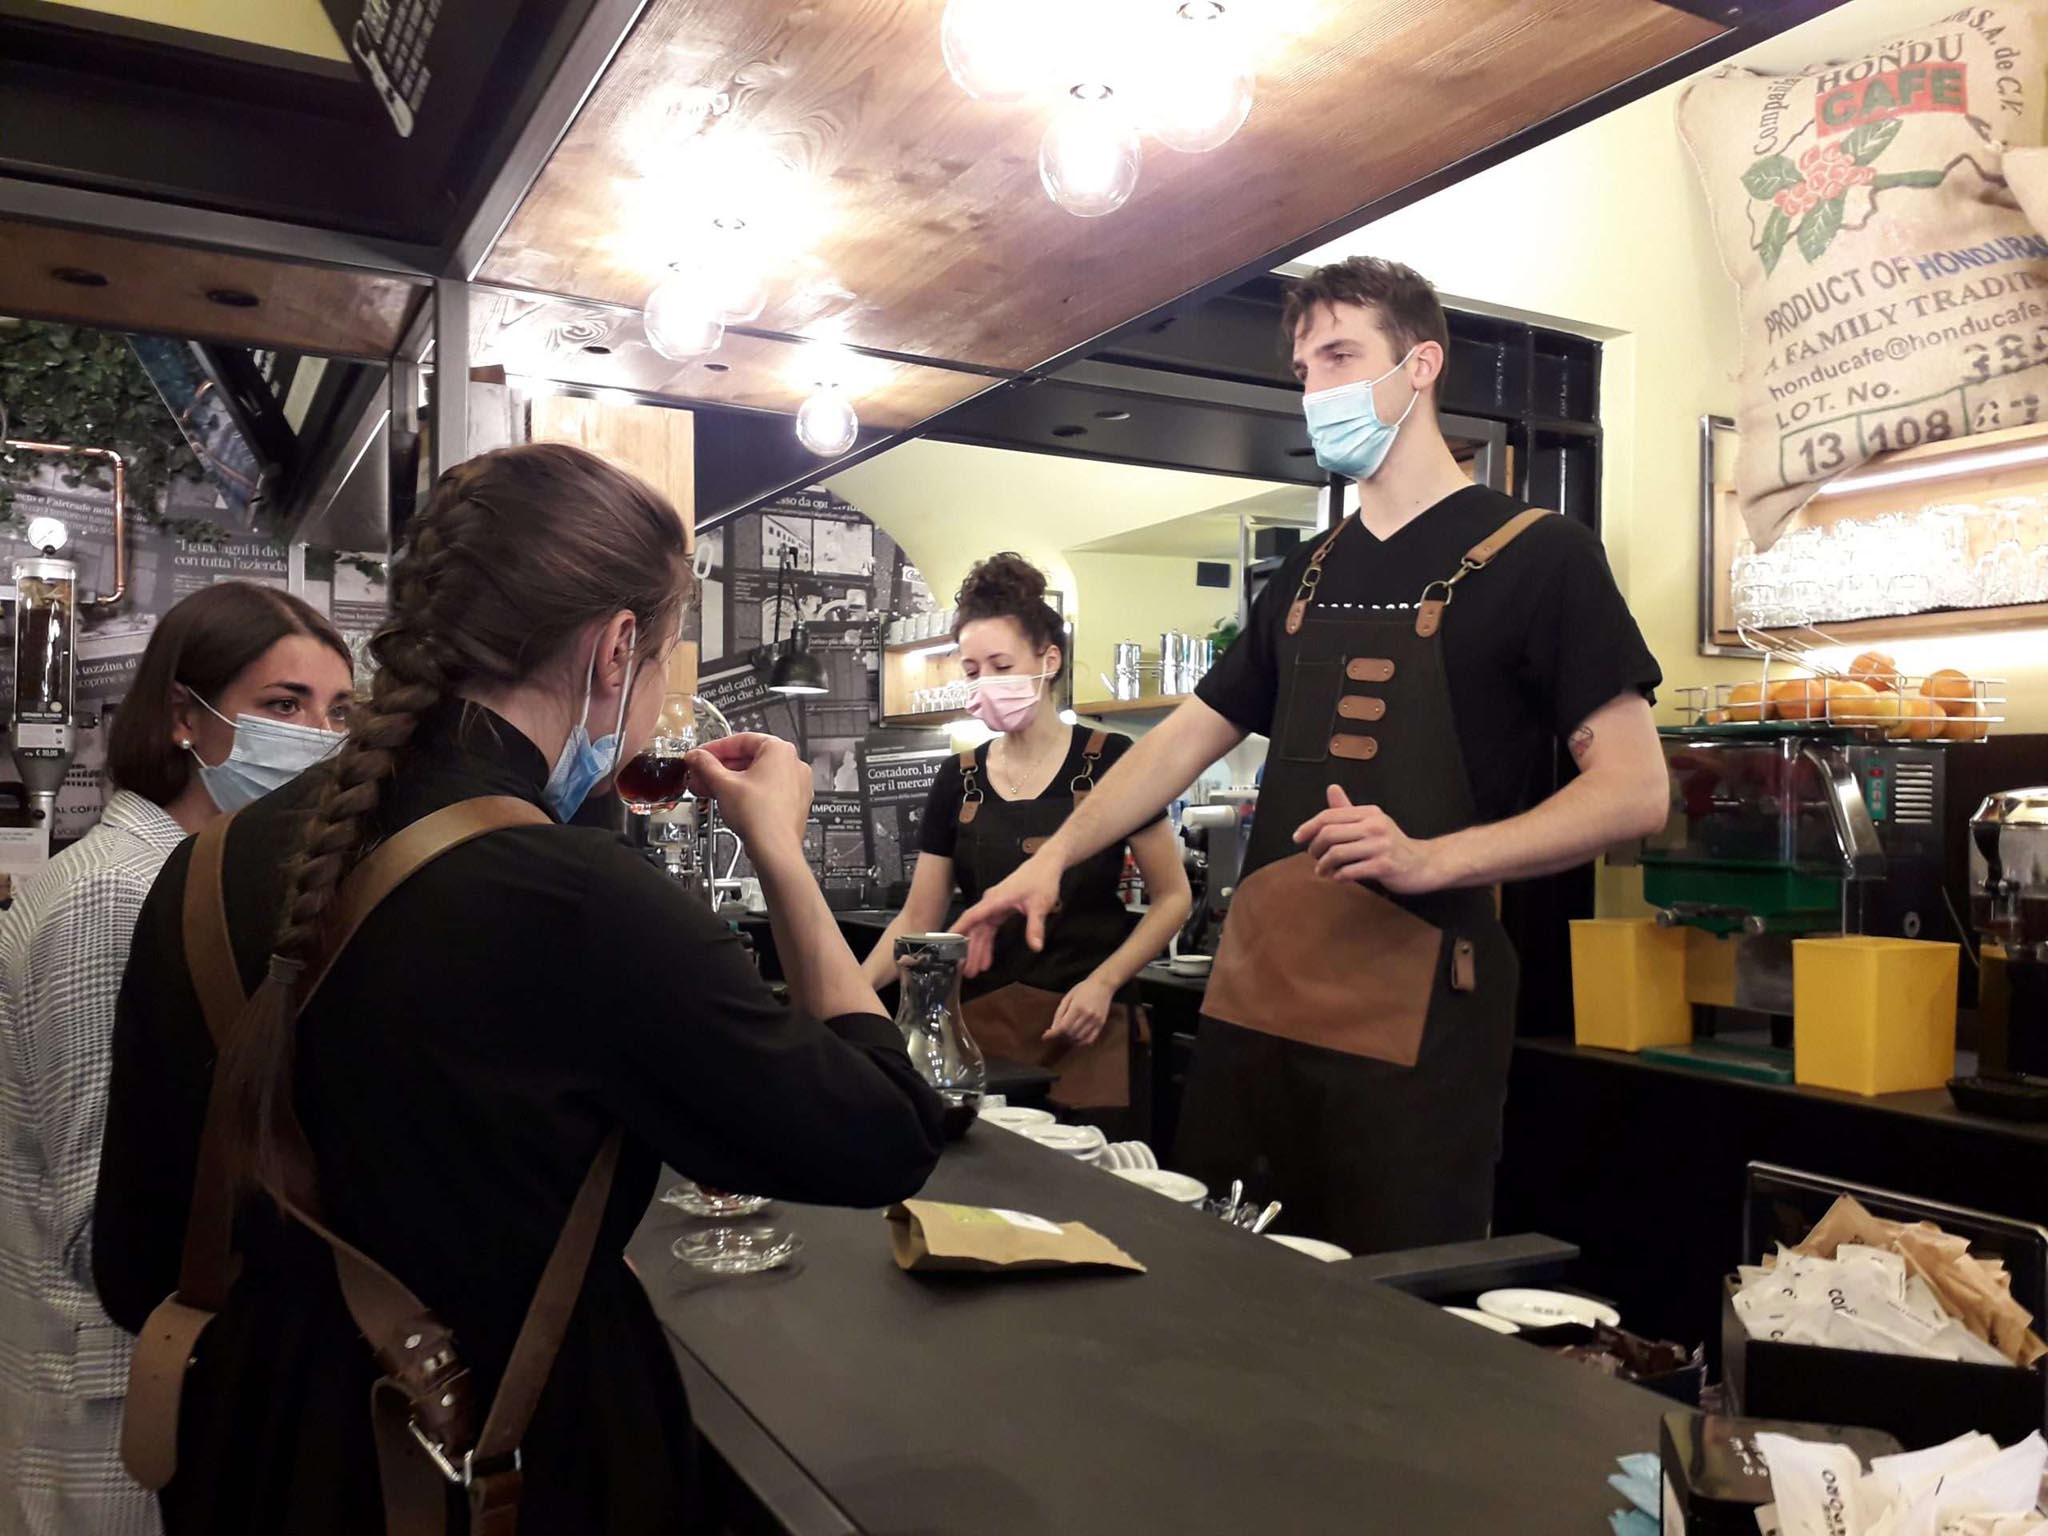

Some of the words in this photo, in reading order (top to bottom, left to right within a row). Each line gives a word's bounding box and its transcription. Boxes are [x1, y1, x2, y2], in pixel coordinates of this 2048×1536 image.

[1816, 32, 1964, 94] HONDU
[1994, 46, 2021, 71] de
[1821, 66, 1961, 127] CAFE
[1764, 268, 1867, 344] PRODUCT
[1870, 256, 1914, 290] OF
[1785, 303, 1898, 366] FAMILY
[1906, 270, 2040, 319] TRADIT
[1776, 392, 1836, 431] LOT.
[1847, 381, 1901, 406] No.
[1868, 408, 1954, 453] 108
[1798, 431, 1846, 476] 13
[174, 556, 199, 567] con
[200, 554, 231, 569] tutta
[718, 681, 733, 694] del
[737, 689, 754, 701] che
[868, 766, 922, 780] Costadoro,
[923, 763, 933, 775] la
[869, 783, 887, 796] per
[888, 779, 896, 791] il
